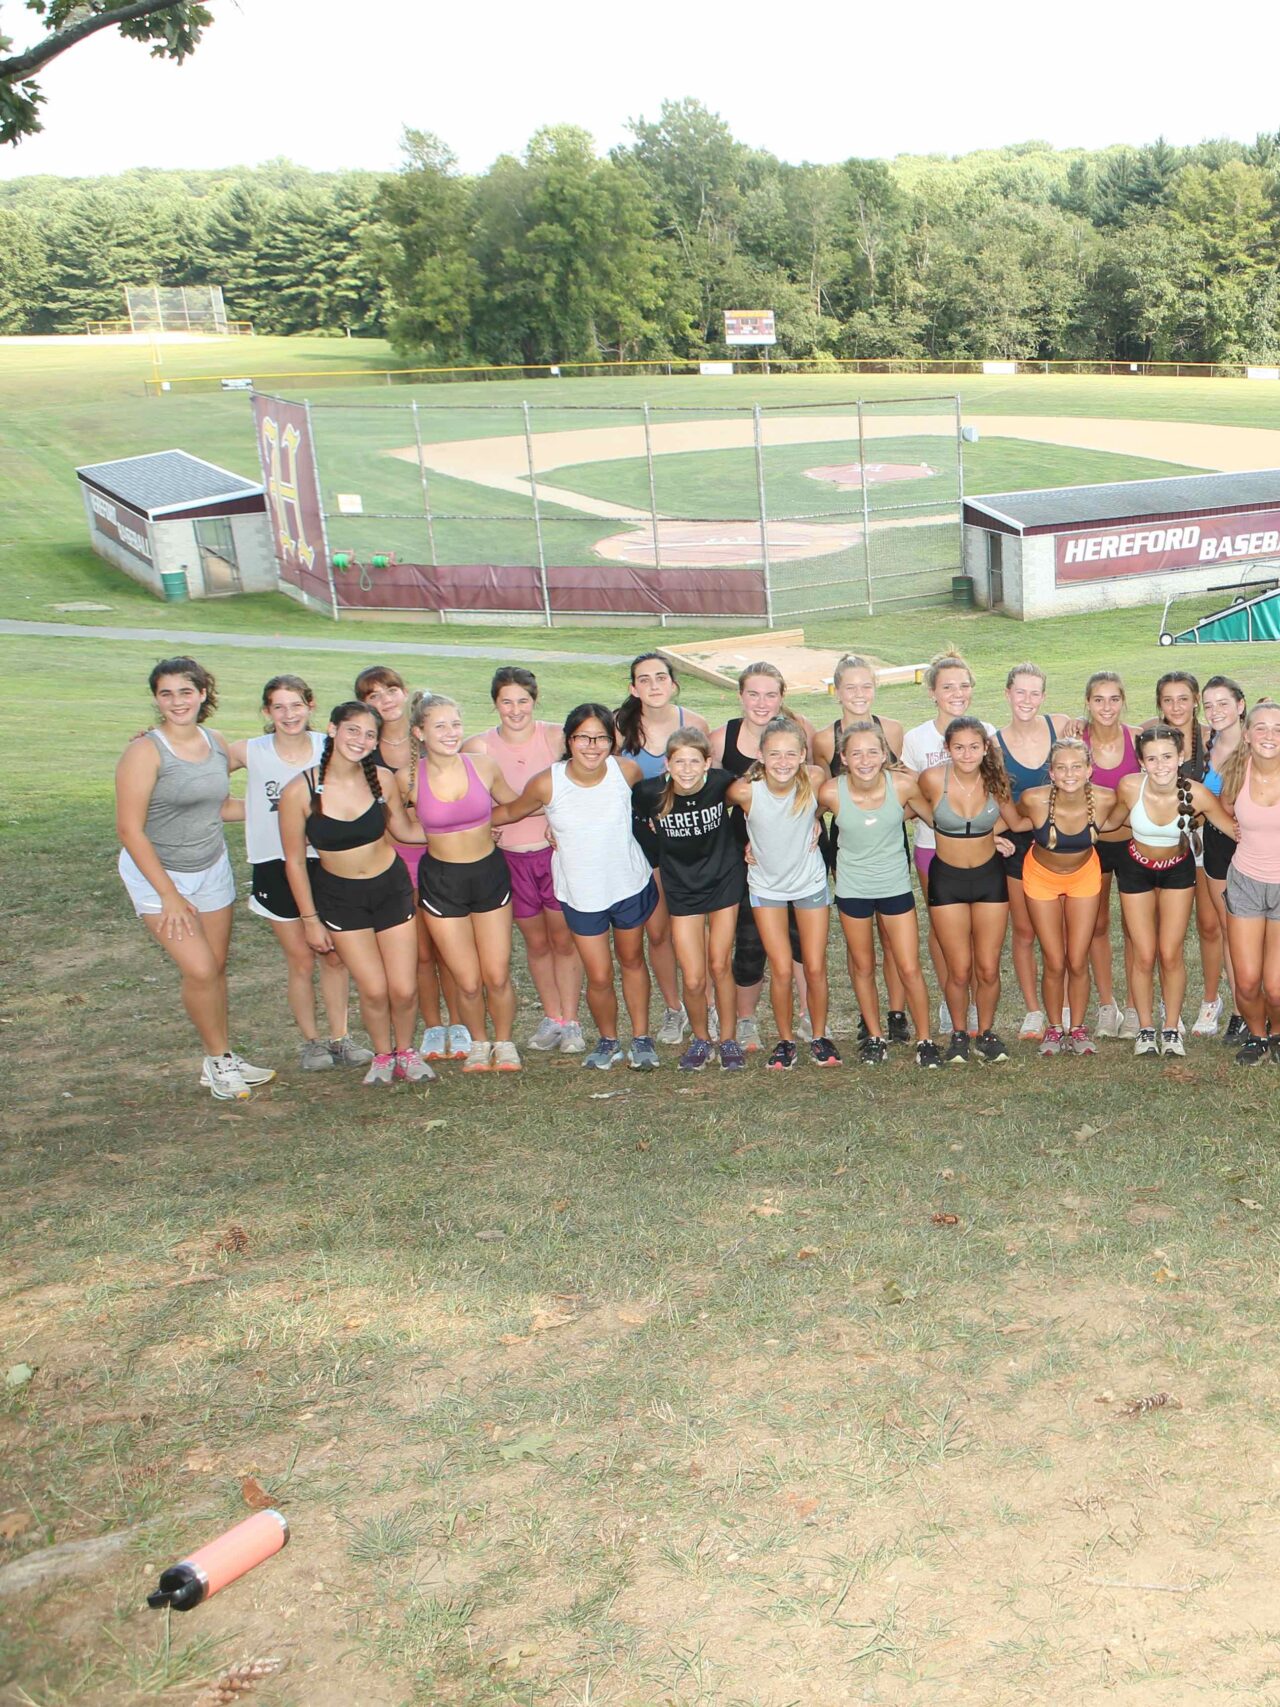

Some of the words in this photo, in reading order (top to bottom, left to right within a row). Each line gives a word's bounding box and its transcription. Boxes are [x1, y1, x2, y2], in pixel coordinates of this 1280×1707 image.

[1064, 526, 1200, 563] HEREFORD
[658, 802, 723, 829] HEREFORD
[665, 828, 692, 838] TRACK
[694, 826, 702, 836] &
[1129, 844, 1149, 865] PRO
